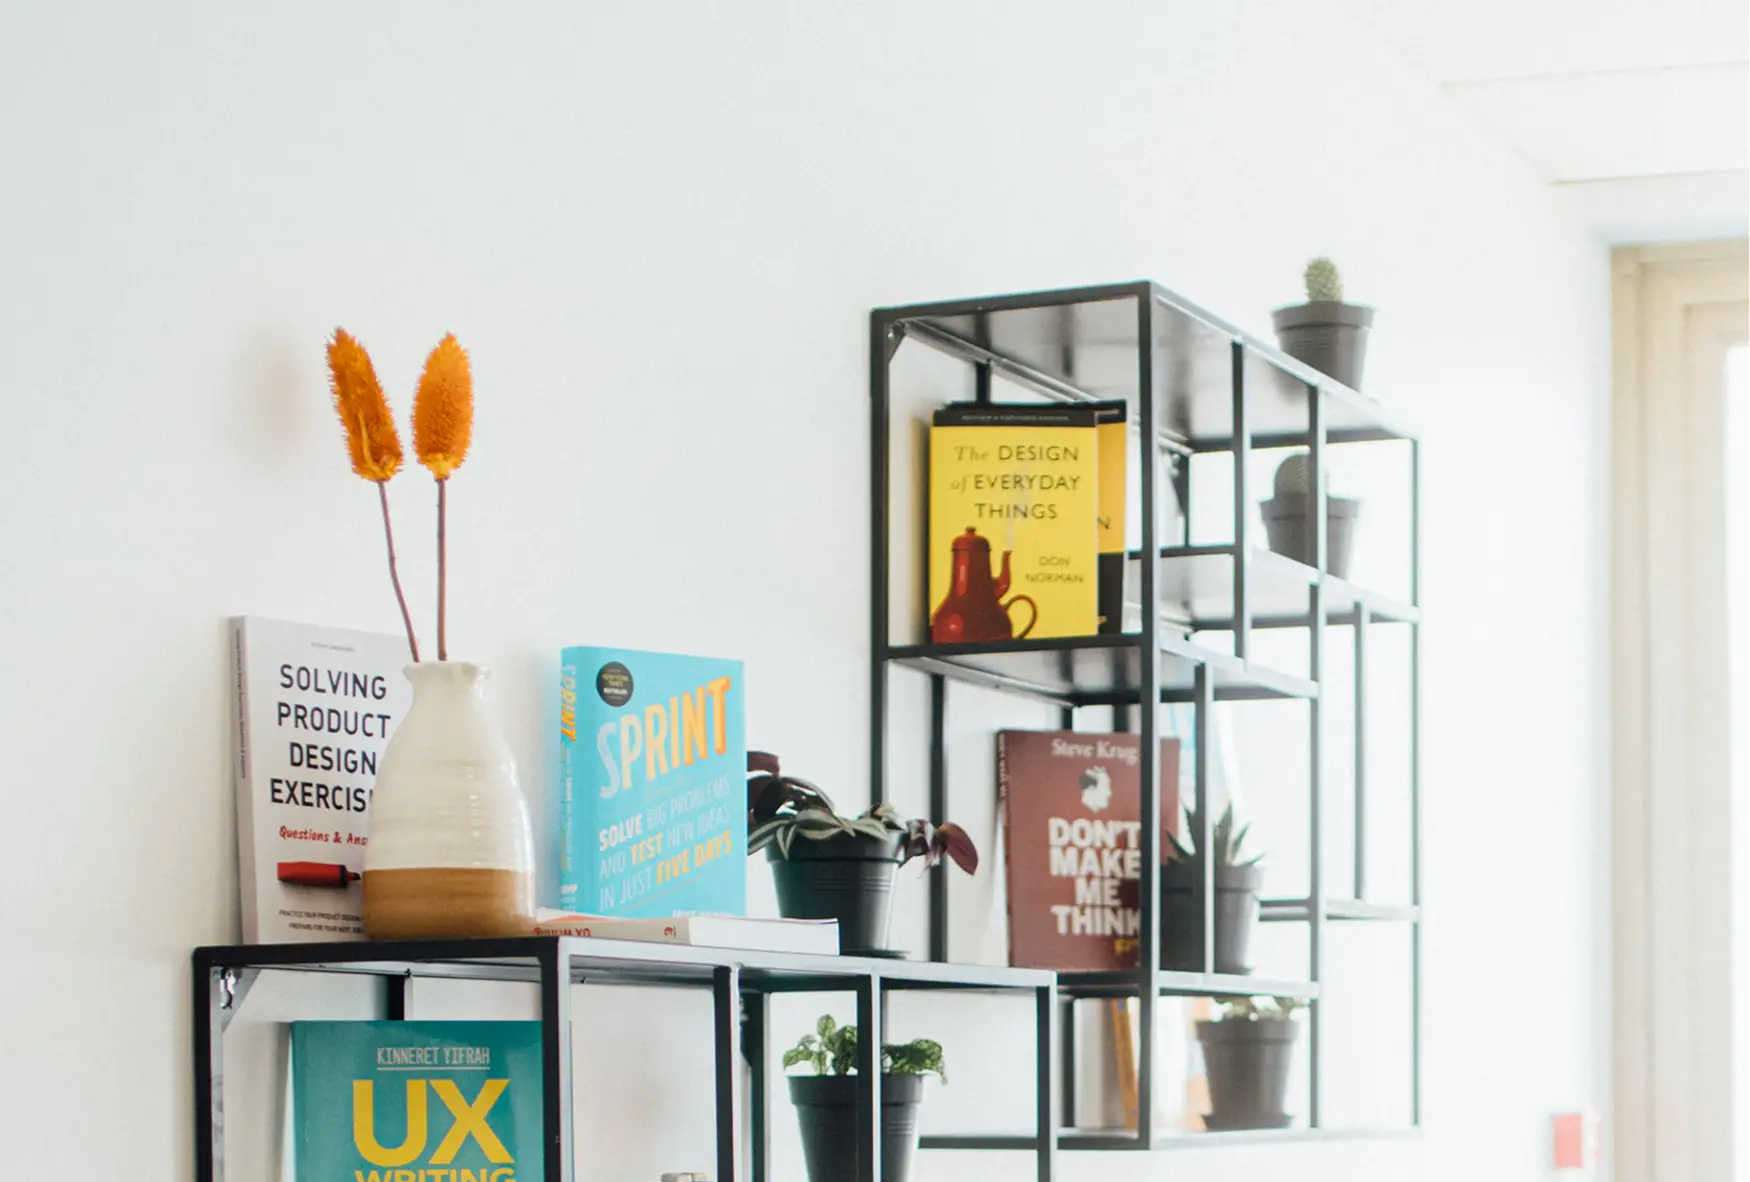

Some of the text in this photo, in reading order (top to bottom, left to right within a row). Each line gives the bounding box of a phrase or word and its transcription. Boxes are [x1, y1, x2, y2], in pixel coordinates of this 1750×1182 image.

[954, 445, 1079, 462] The DESIGN
[974, 474, 1081, 491] EVERYDAY
[974, 503, 1058, 520] THINGS
[1039, 556, 1070, 567] DON
[1025, 572, 1084, 584] NORMAN
[280, 663, 387, 700] SOLVING
[277, 702, 391, 739] PRODUCT
[598, 675, 730, 799] SPRINT
[1051, 738, 1140, 766] Steve Krug
[289, 741, 376, 775] DESIGN
[270, 777, 373, 813] EXERCIS
[599, 813, 643, 851] SOLVE
[646, 801, 667, 831] BIG
[670, 774, 731, 819] PROBLEMS
[279, 825, 329, 843] Questions
[333, 831, 342, 844] &
[600, 802, 731, 880] AND TEST NEW IDEAS
[1048, 817, 1141, 848] DON'T
[600, 886, 615, 913] IN
[620, 867, 652, 905] JUST
[656, 848, 690, 886] FIVE
[694, 830, 733, 869] DAYS
[1050, 847, 1141, 878] MAKE
[1075, 877, 1121, 906] ME
[377, 1046, 490, 1065] KINNERET YIFRAH
[352, 1079, 515, 1167] UX
